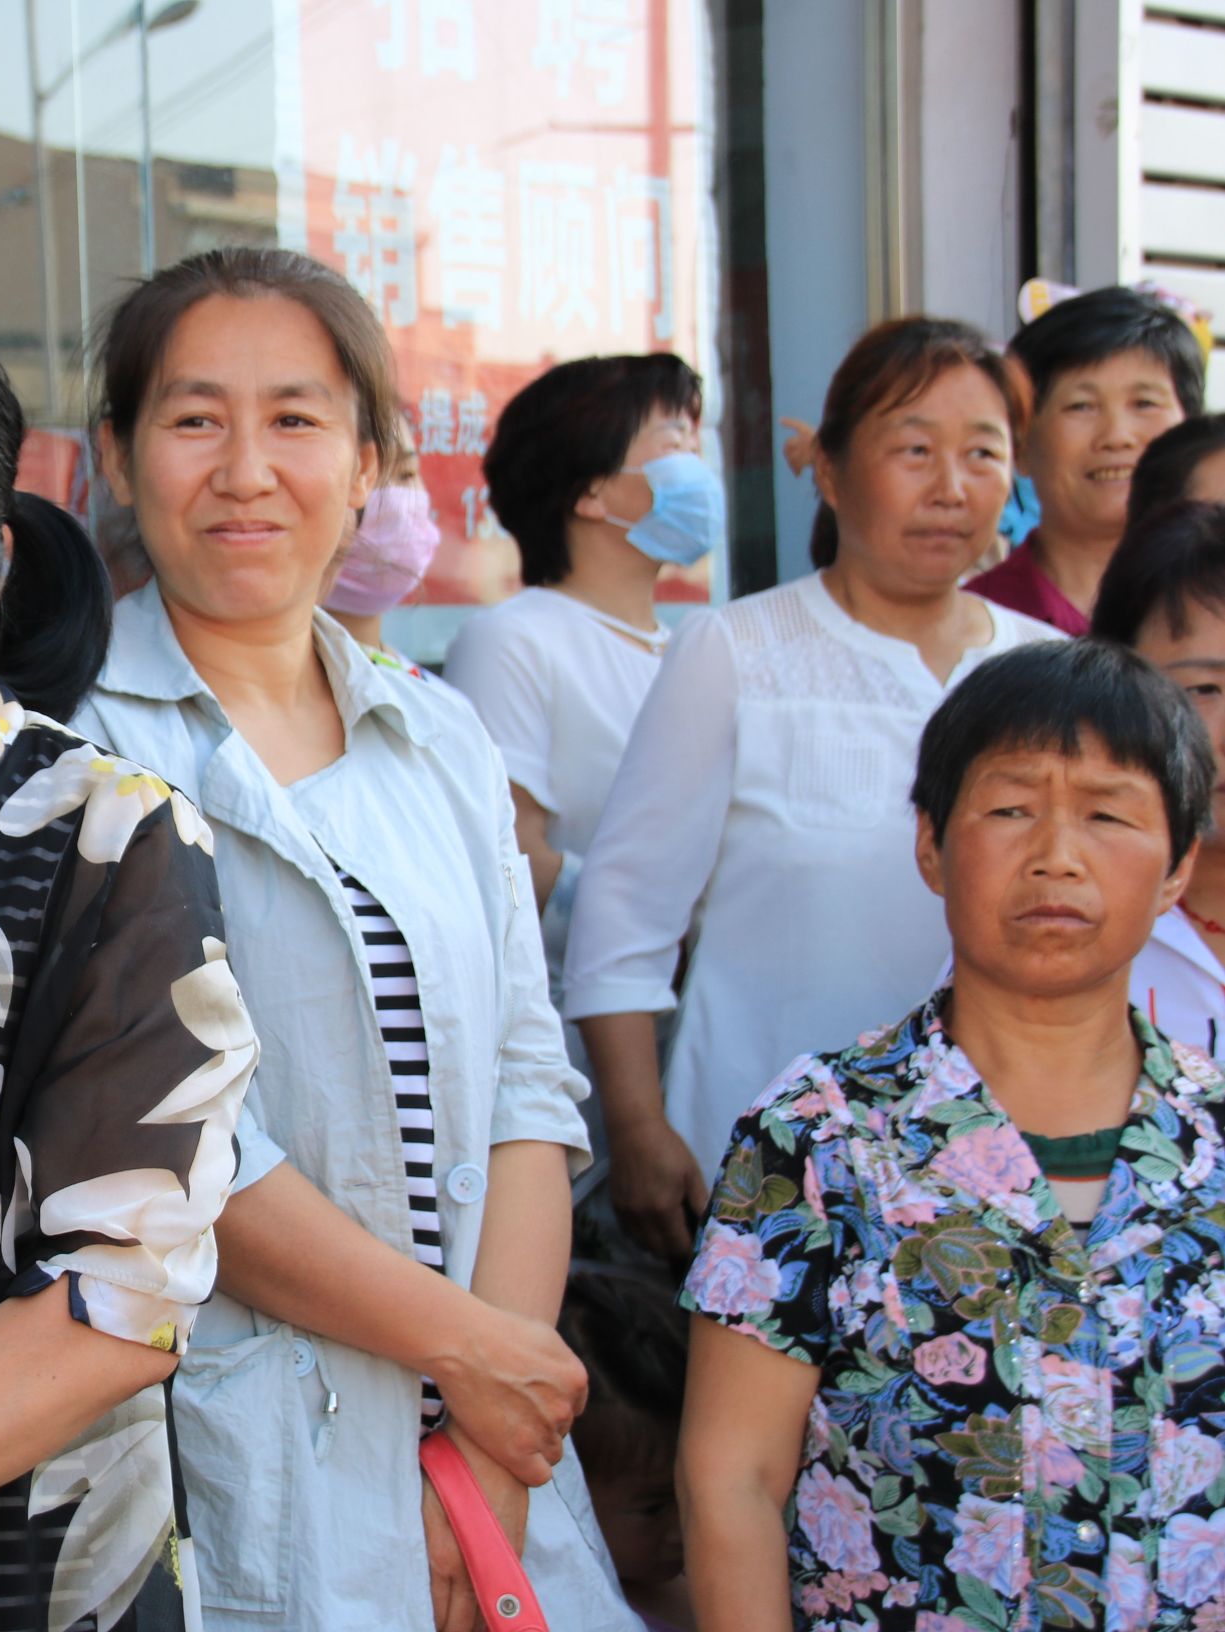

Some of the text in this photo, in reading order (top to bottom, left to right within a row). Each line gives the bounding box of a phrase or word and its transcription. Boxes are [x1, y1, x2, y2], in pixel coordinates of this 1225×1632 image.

[330, 132, 673, 340] 销售顾问
[408, 388, 489, 456] 提成
